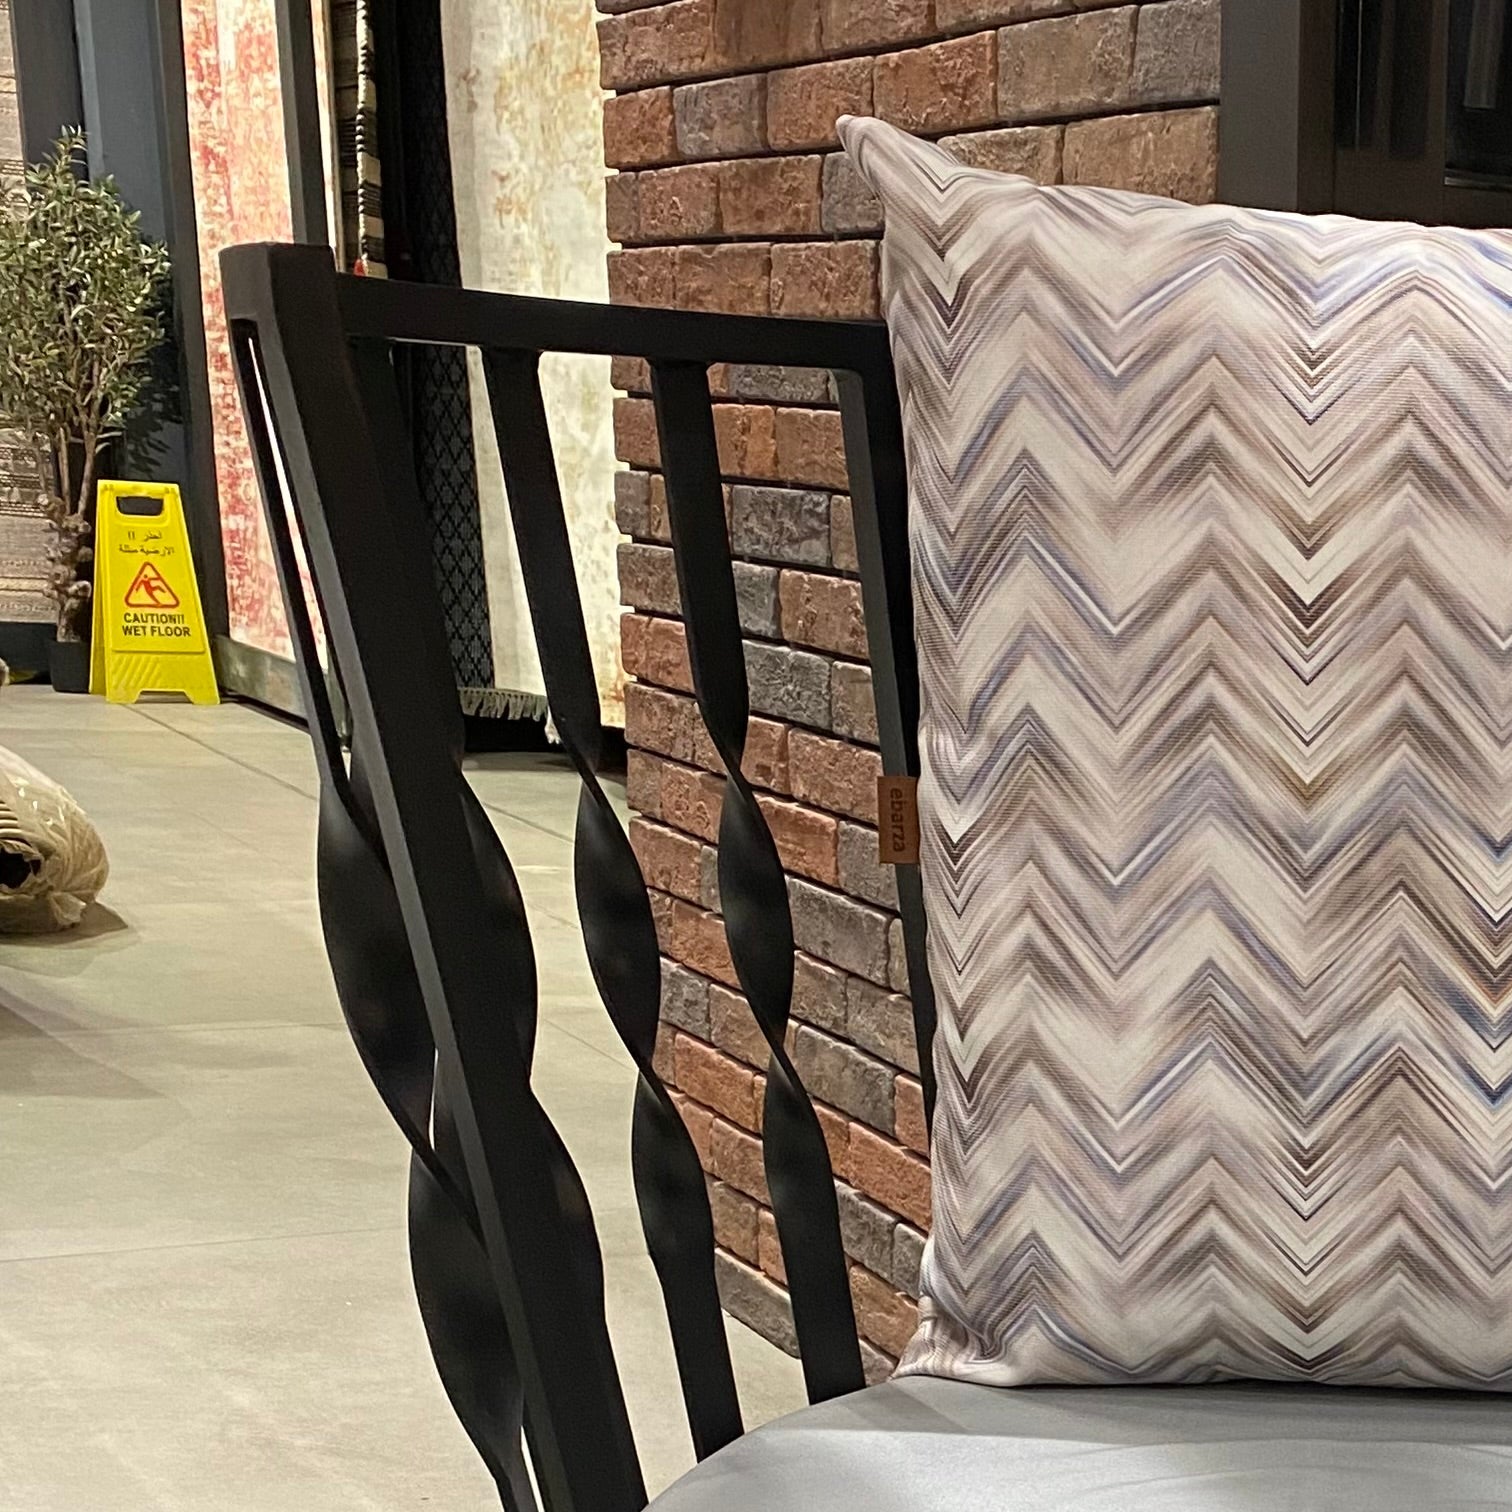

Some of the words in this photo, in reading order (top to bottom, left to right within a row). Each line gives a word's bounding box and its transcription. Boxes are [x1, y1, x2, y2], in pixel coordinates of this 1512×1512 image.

[122, 625, 148, 637] WET
[150, 625, 191, 637] FLOOR
[890, 788, 906, 852] ebarza
